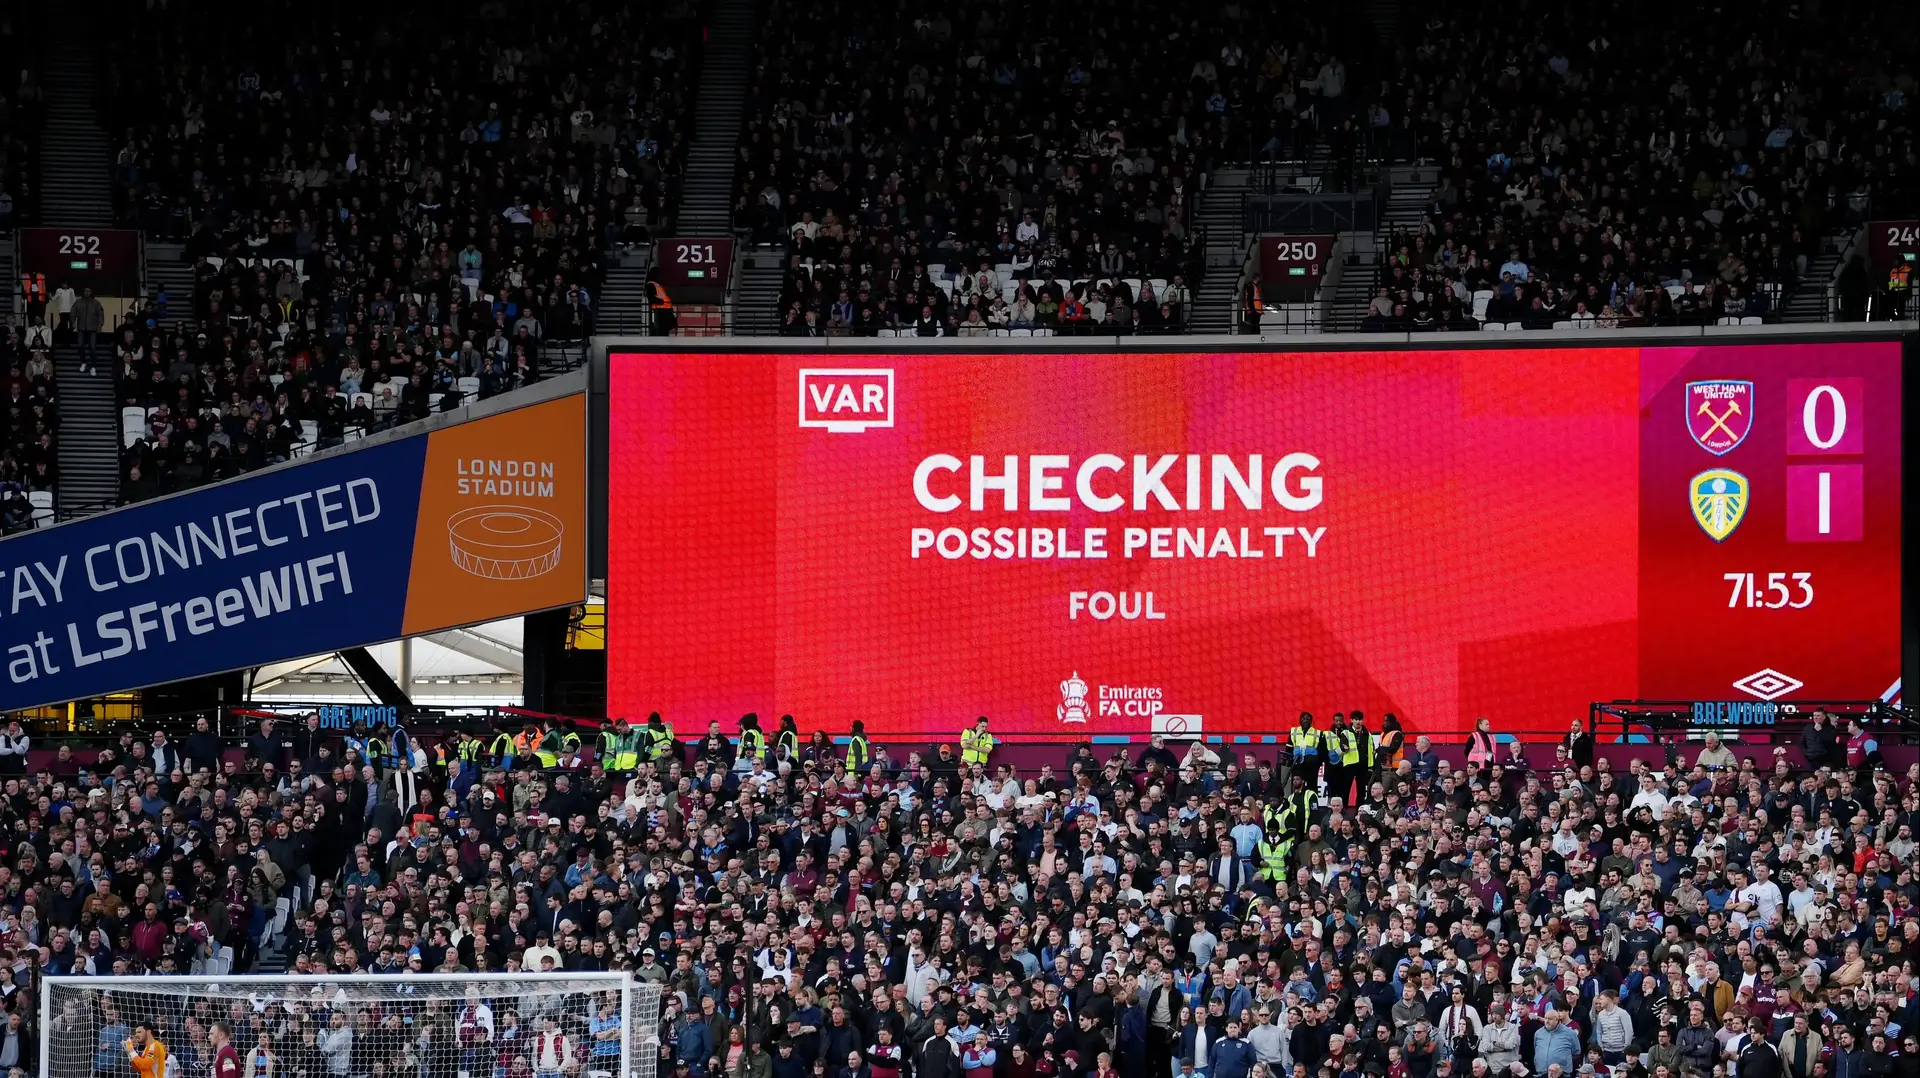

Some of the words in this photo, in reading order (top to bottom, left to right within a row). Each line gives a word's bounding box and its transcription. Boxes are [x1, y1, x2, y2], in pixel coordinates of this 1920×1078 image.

[59, 235, 100, 255] 252
[676, 244, 716, 263] 251
[1277, 242, 1317, 261] 250
[808, 383, 885, 413] VAR
[1693, 384, 1720, 394] WEST
[1721, 384, 1746, 394] HAM
[1704, 391, 1735, 399] UNITED
[1803, 385, 1847, 449] 0
[458, 458, 554, 478] LONDON
[458, 478, 554, 497] STADIUM
[912, 452, 1324, 512] CHECKING
[0, 554, 68, 616] AY
[84, 477, 381, 592] CONNECTED
[911, 527, 1108, 559] POSSIBLE
[1124, 526, 1327, 559] PENALTY
[1723, 572, 1814, 609] 71:53
[8, 631, 60, 683] at
[66, 551, 353, 668] LSFreeWIFI
[1069, 591, 1166, 620] FOUL
[1098, 685, 1163, 700] Emirates
[319, 705, 397, 729] BREWDOG
[1098, 701, 1122, 716] FA
[1124, 700, 1164, 717] CUP
[1693, 701, 1776, 725] BREWDOG
